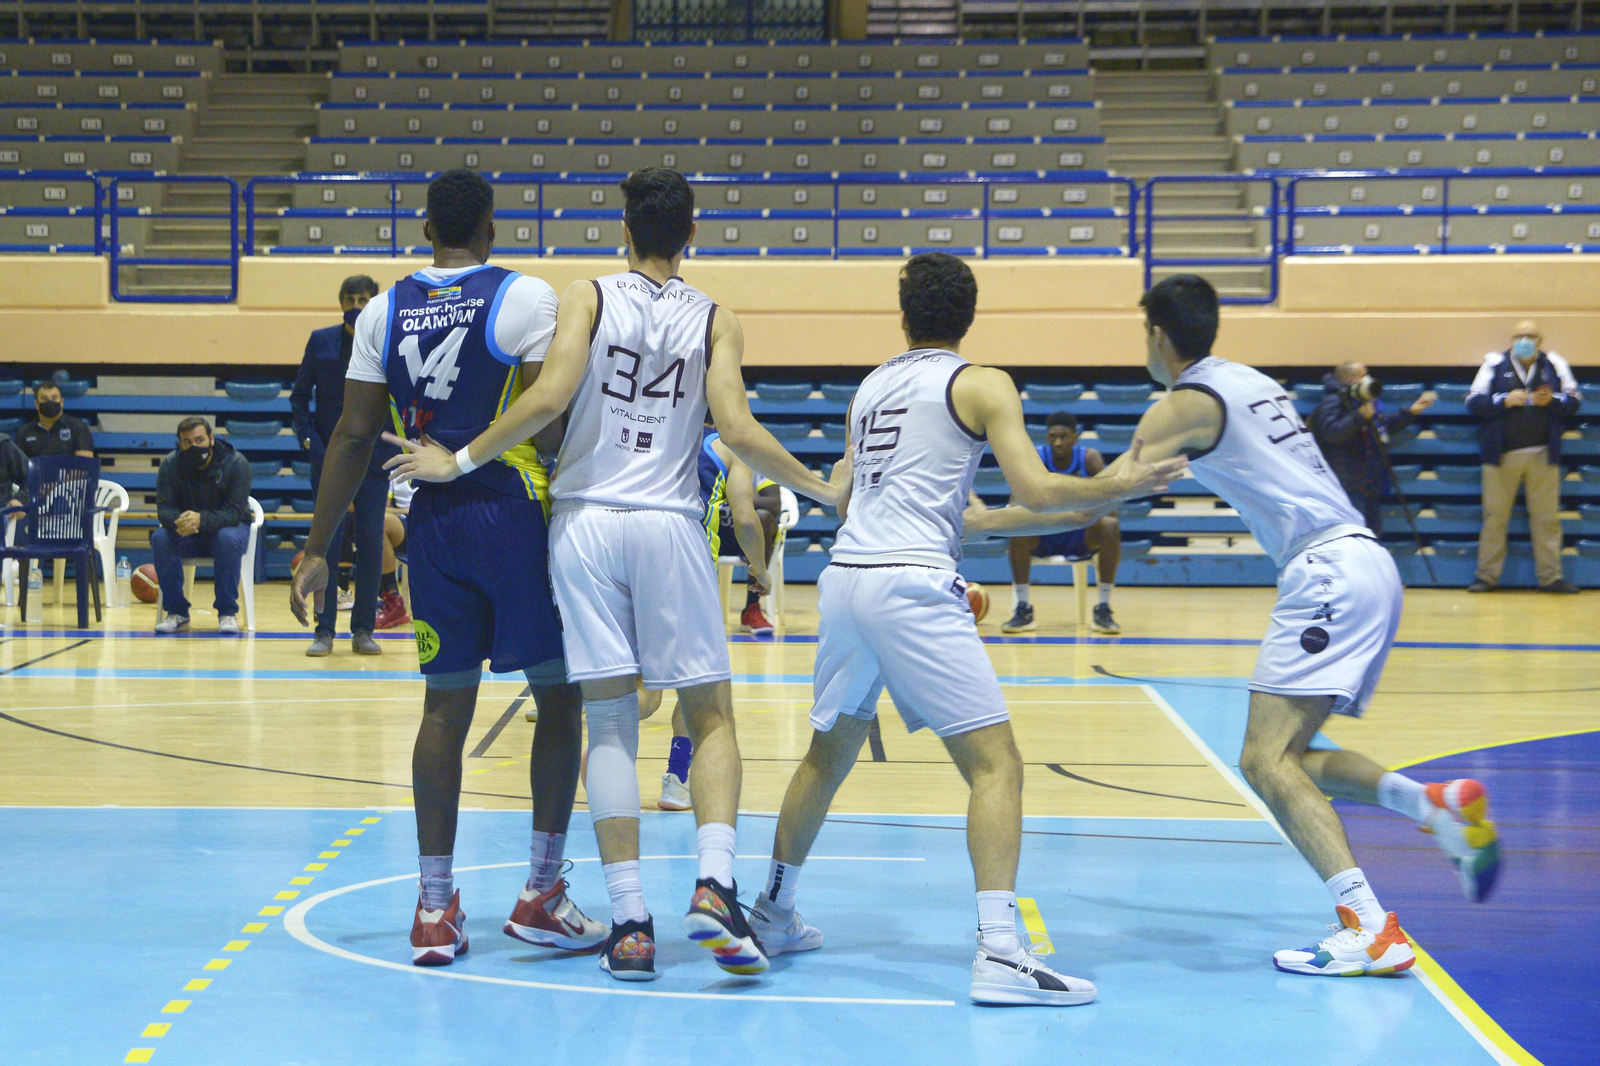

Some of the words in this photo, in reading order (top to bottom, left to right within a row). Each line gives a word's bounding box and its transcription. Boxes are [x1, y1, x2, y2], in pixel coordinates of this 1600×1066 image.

[616, 279, 696, 304] BASTANTE
[398, 326, 469, 401] 14
[601, 344, 686, 409] 34
[609, 405, 667, 424] VITALDENT
[858, 408, 909, 454] 15
